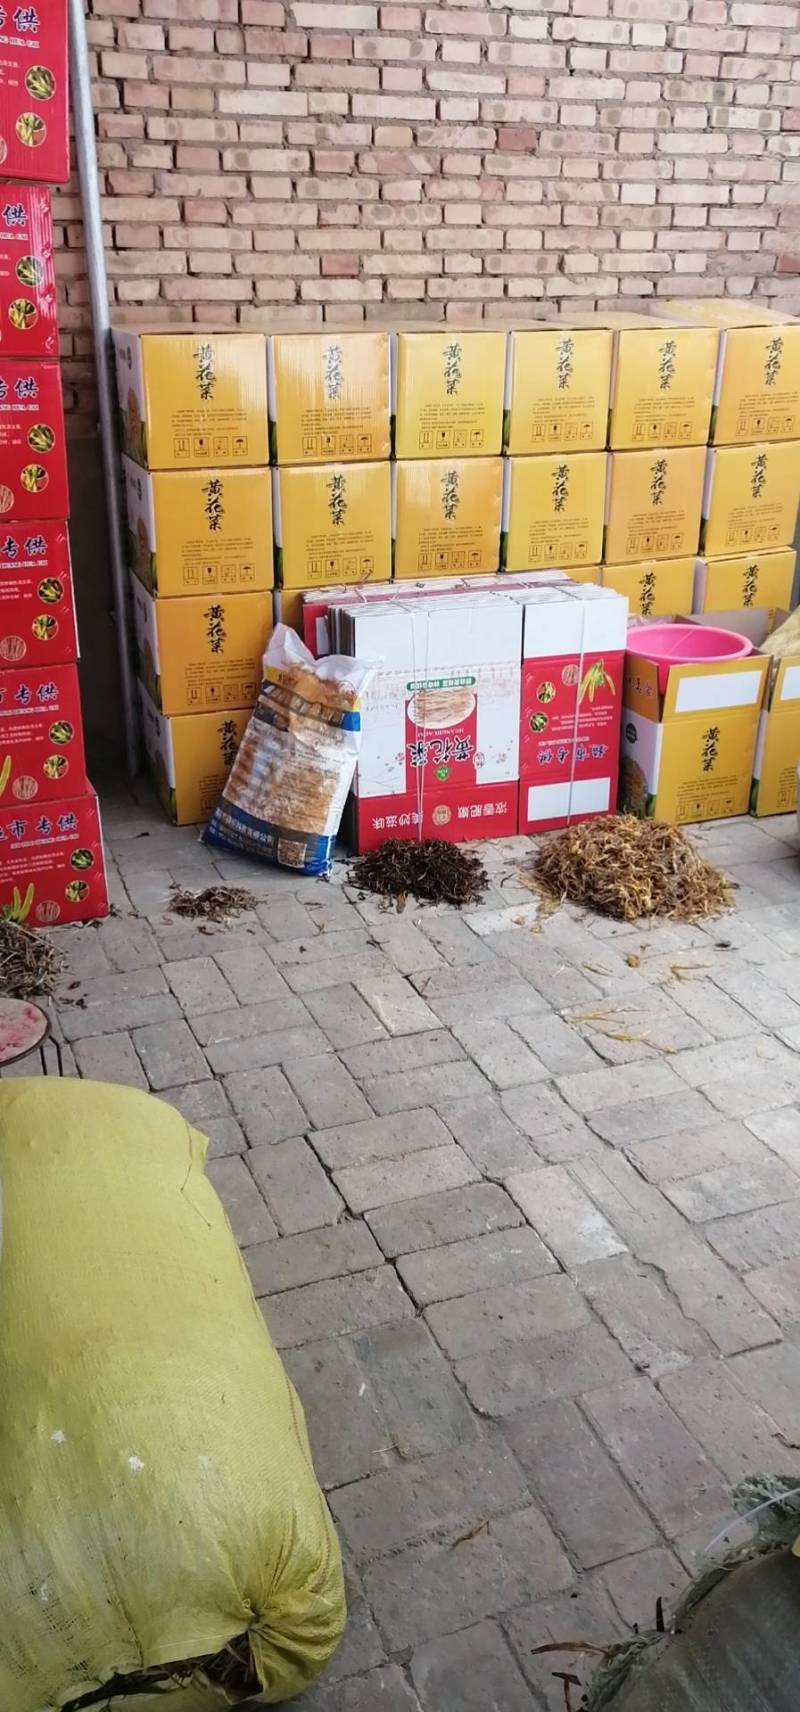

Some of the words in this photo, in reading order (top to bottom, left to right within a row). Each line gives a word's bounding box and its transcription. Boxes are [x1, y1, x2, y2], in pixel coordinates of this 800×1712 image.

[2, 203, 28, 227] 供
[193, 343, 216, 400] 黄花菜
[322, 345, 344, 400] 黄花菜
[442, 343, 462, 395] 黄花菜
[555, 338, 574, 390] 黄花菜
[658, 340, 676, 390] 黄花菜
[765, 337, 783, 386] 黄花菜
[441, 470, 461, 520] 黄花菜
[552, 464, 570, 512] 黄花菜
[650, 459, 667, 505] 黄花菜
[751, 454, 767, 498] 黄花菜
[201, 479, 224, 531] 黄花菜
[326, 474, 347, 528] 黄花菜
[638, 572, 656, 616] 黄花菜
[742, 565, 759, 608] 黄花菜
[203, 604, 227, 655] 黄花菜
[407, 735, 474, 768] 黄花菜
[702, 726, 720, 772] 黄花菜
[457, 802, 507, 819] 浓香肥嫩
